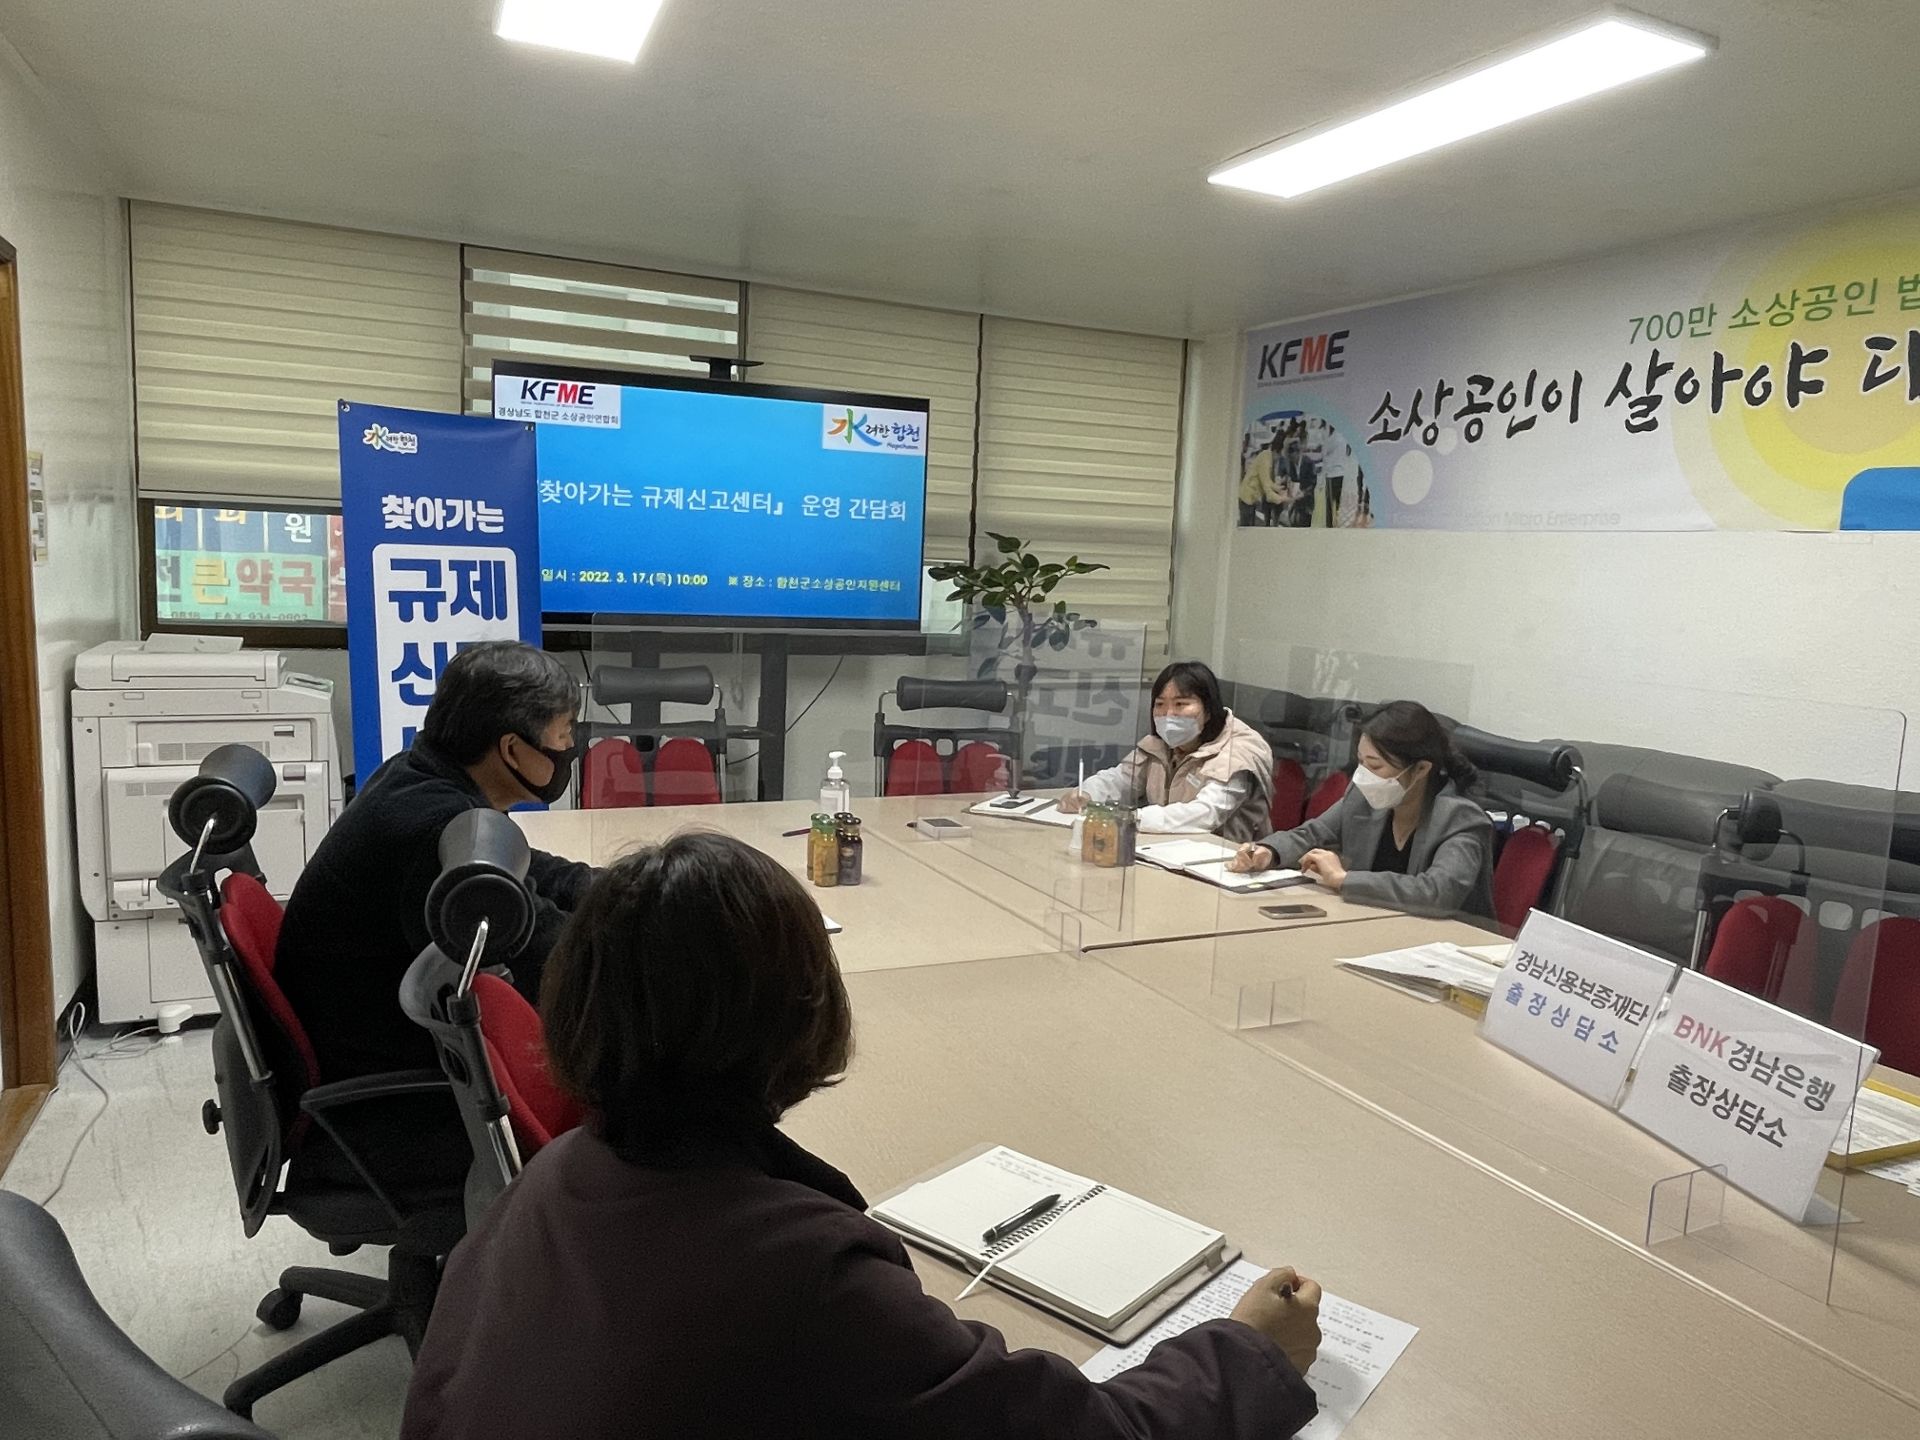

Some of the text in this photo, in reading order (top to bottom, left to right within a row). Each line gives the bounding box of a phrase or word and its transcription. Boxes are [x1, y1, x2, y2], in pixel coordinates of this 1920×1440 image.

[1628, 303, 1717, 345] 700만
[1728, 277, 1878, 331] 소상공인
[1257, 330, 1350, 380] KFME
[498, 406, 619, 425] 경상남도 합천군 소상공인연합회
[520, 379, 596, 406] KFME
[1366, 368, 1583, 447] 소상공인이
[1604, 340, 1830, 435] 살아야
[382, 494, 505, 534] 찾아가는
[537, 479, 634, 508] 찾아가는
[801, 494, 841, 519] 운영
[848, 498, 907, 522] 간담회
[389, 558, 508, 622] 규제
[541, 568, 567, 582] 일시
[616, 572, 628, 584] 3.
[676, 573, 709, 586] 10:00
[742, 575, 766, 588] 장소
[391, 641, 478, 706] 신
[1514, 949, 1650, 1027] 경남신용보증재단
[1668, 1062, 1789, 1149] 출장상담소
